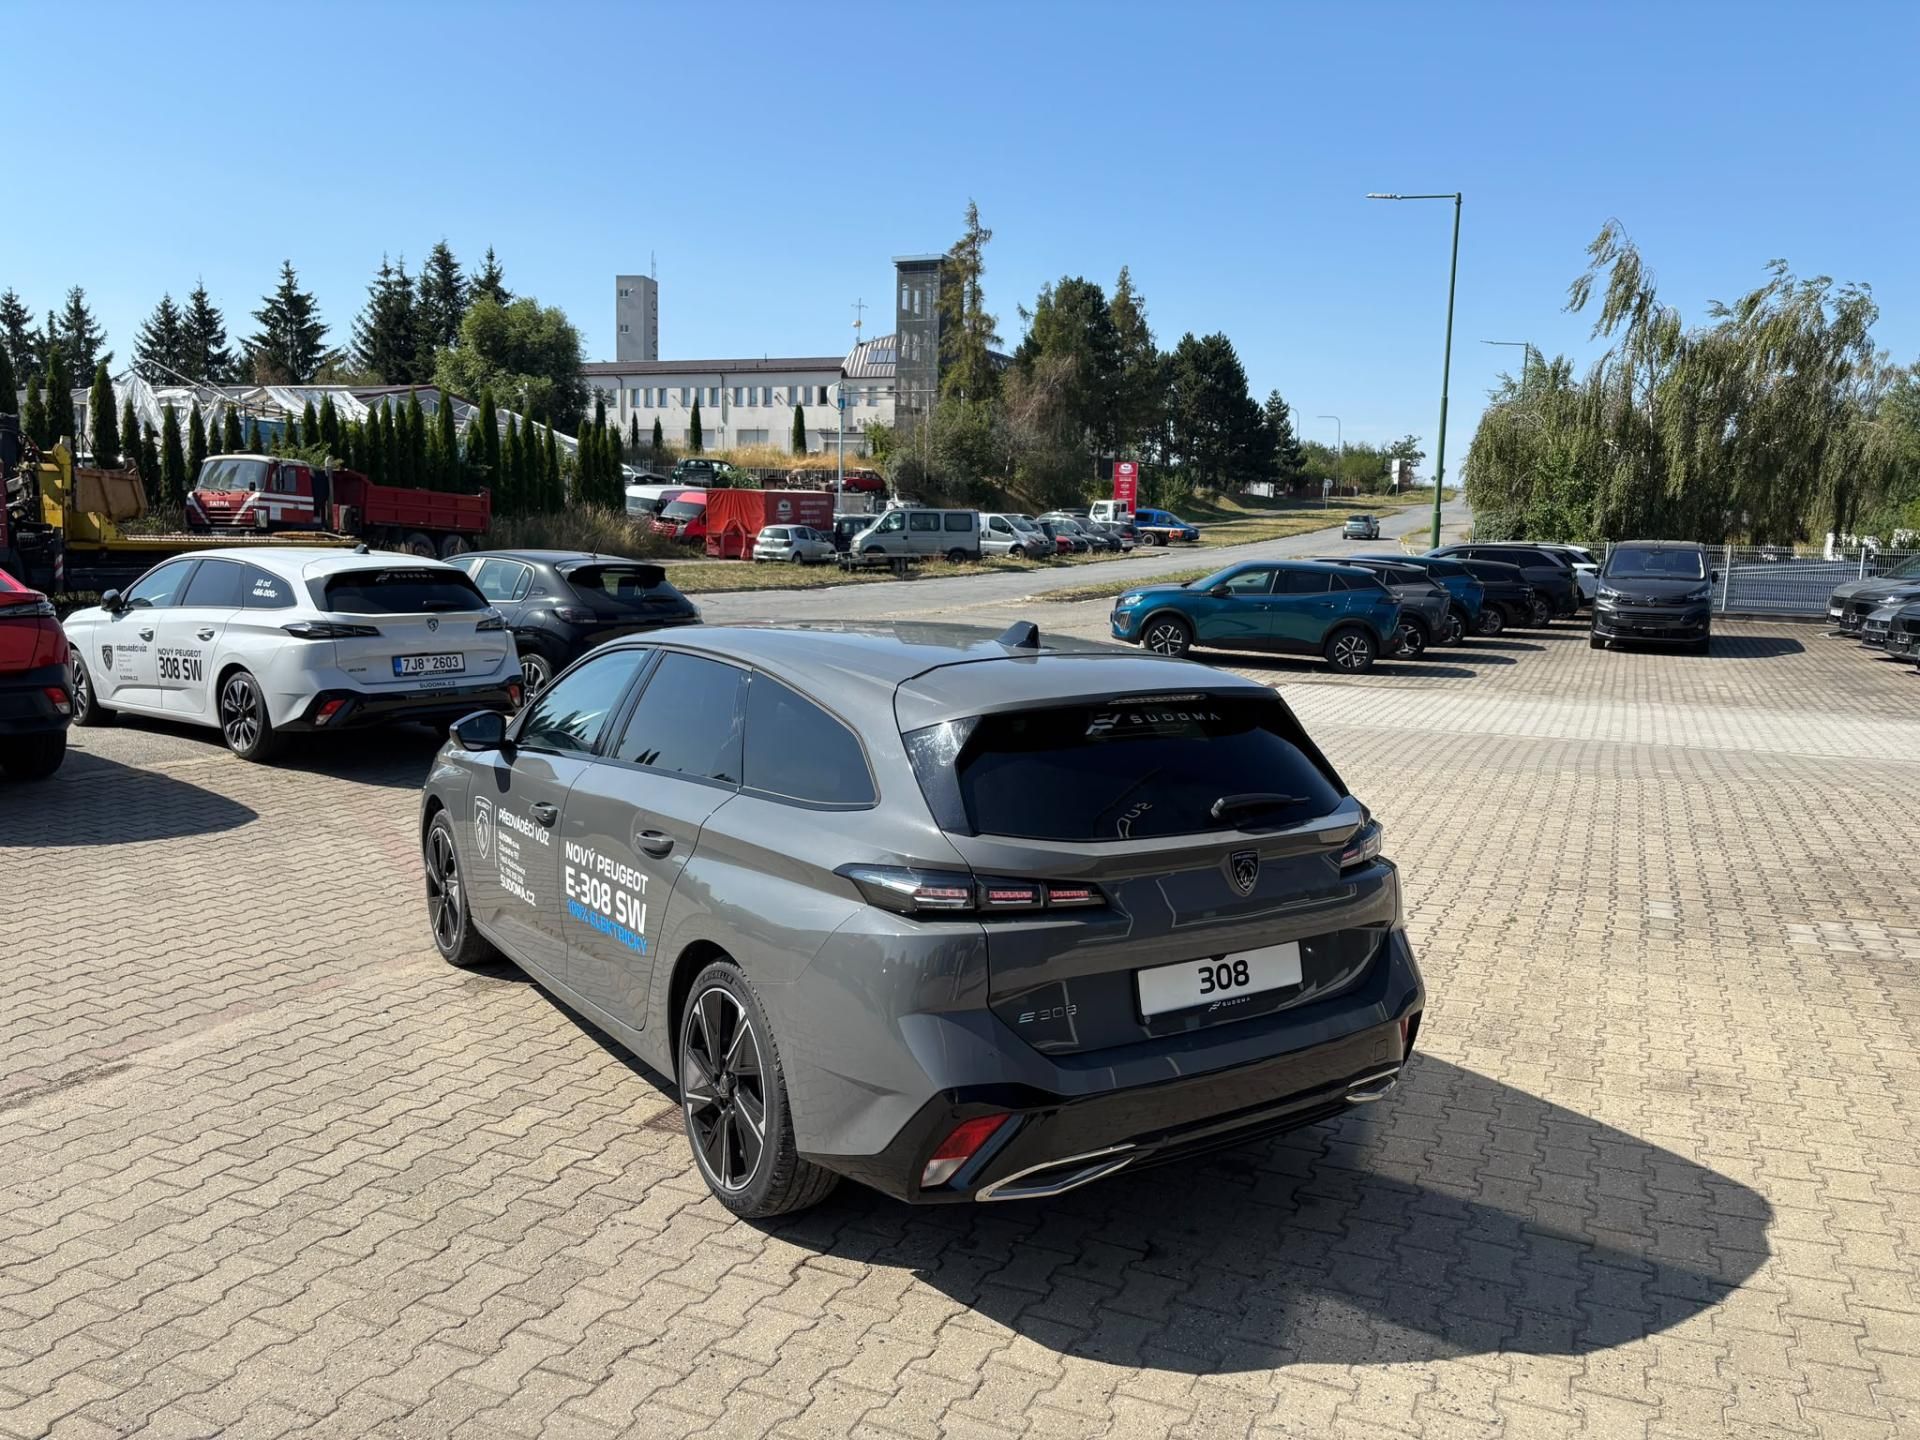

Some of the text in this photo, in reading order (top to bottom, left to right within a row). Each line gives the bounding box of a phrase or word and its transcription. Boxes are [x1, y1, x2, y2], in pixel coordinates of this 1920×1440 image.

[175, 648, 202, 658] PEUGEOT
[403, 655, 460, 671] 7J8 2603
[158, 656, 203, 682] 308 SW
[535, 826, 550, 847] VŮZ
[565, 840, 596, 870] NOVÝ
[597, 854, 649, 896] PEUGEOT
[565, 865, 612, 916] E-308
[615, 890, 648, 936] SW
[1198, 959, 1250, 995] 308
